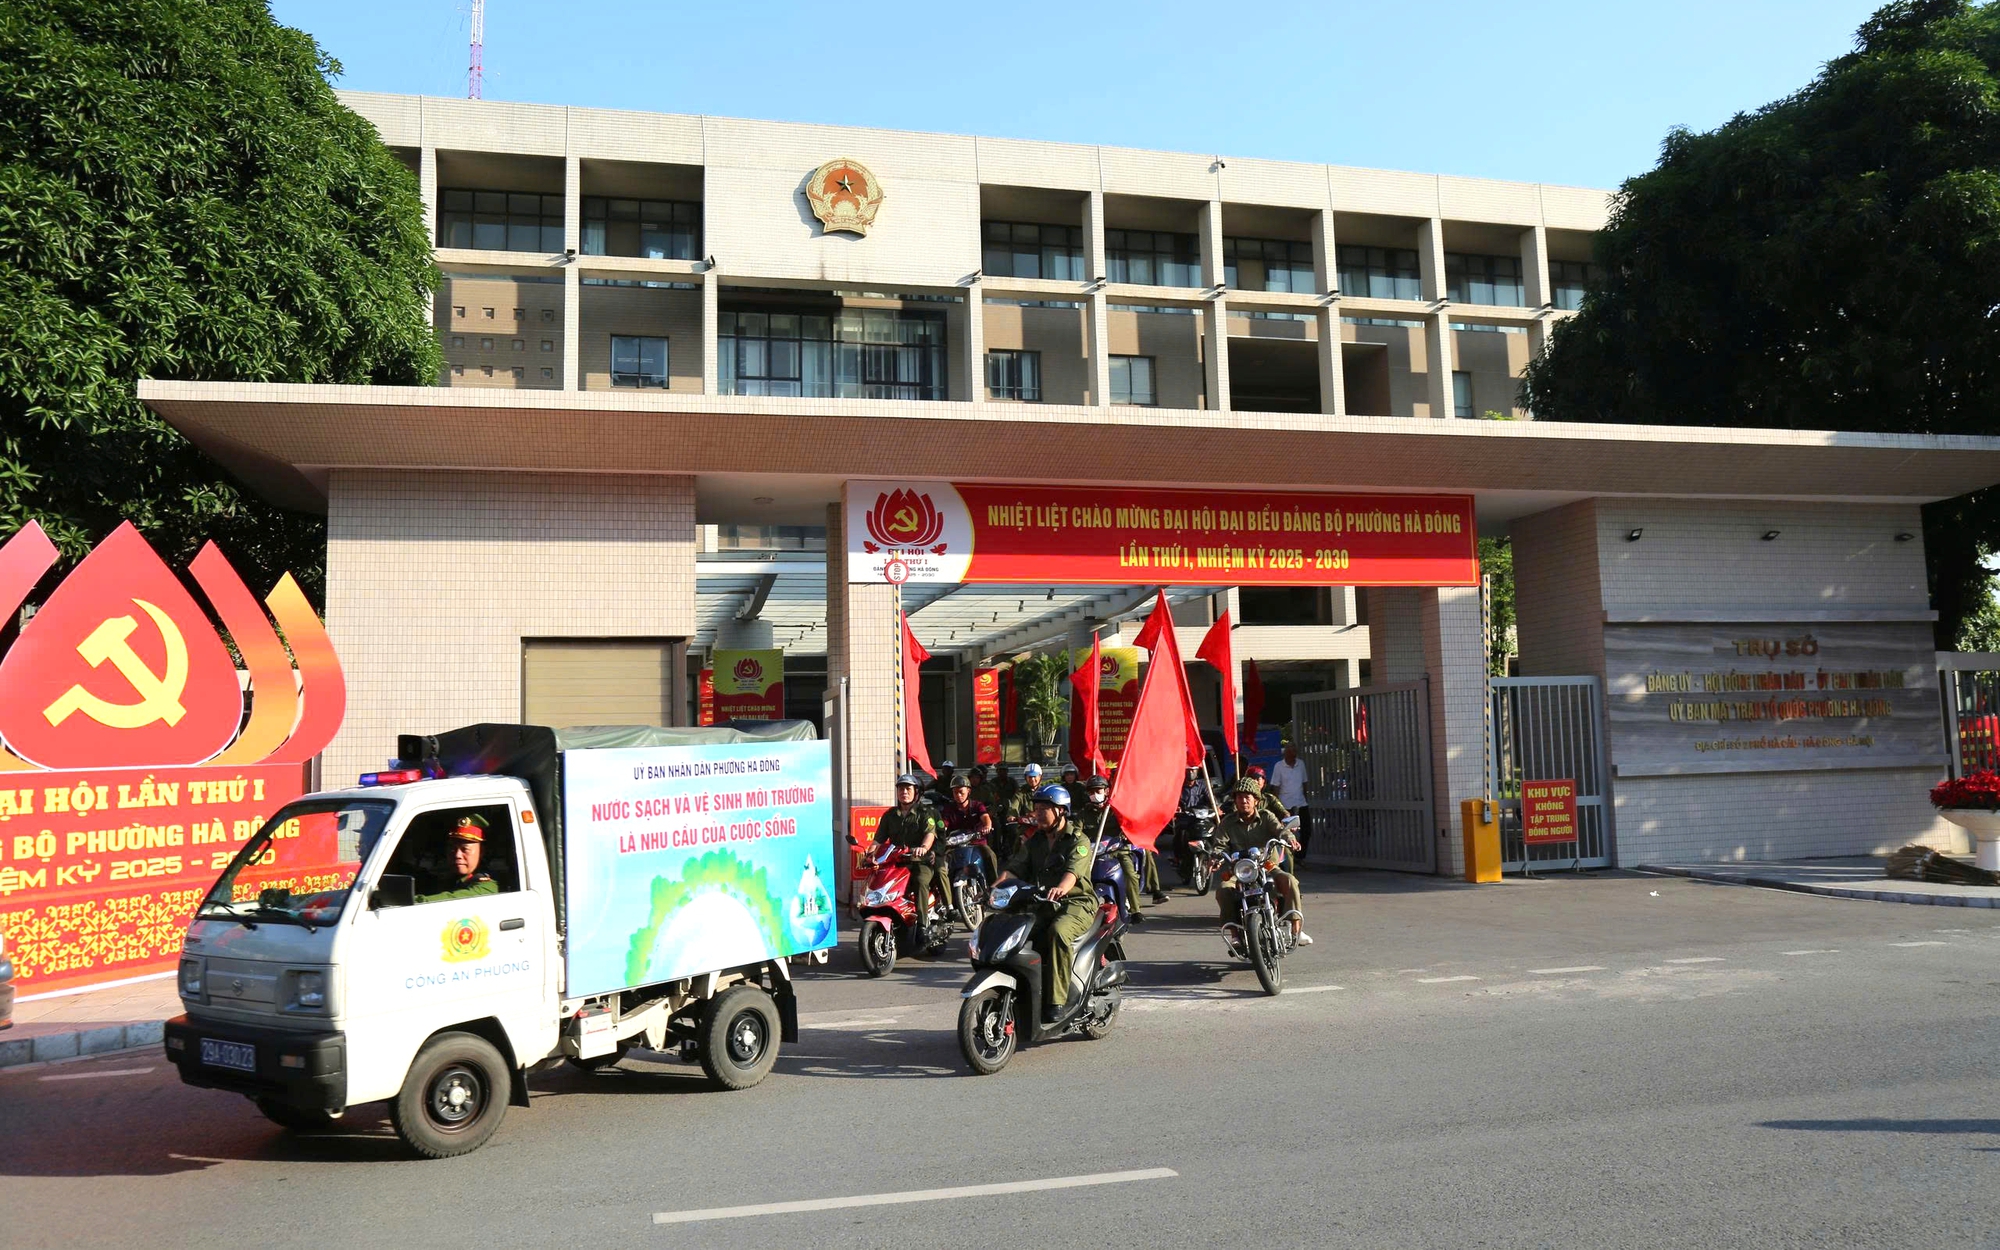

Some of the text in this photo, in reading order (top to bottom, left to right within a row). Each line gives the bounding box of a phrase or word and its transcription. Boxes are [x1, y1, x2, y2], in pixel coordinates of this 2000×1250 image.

[988, 502, 1461, 537] NHIỆT LIỆT CHÀO MỪNG ĐẠI HỘI ĐẠI BIỂU ĐẢNG BỘ PHƯỜNG HÀ ĐÔNG
[1120, 539, 1149, 568] LẦN
[1152, 542, 1181, 568] THỨ
[1184, 547, 1194, 570] I,
[1197, 543, 1245, 572] NHIỆM
[1248, 543, 1266, 569] KỲ
[1269, 548, 1304, 570] 2025
[1315, 548, 1349, 570] 2030
[893, 563, 901, 581] STOP
[1731, 633, 1819, 661] TRỤ SỞ
[1646, 668, 1676, 692] ĐẢNG
[1686, 702, 1709, 721] BAN
[648, 765, 666, 779] BAN
[668, 762, 692, 778] NHÂN
[694, 761, 711, 776] DÂN
[714, 759, 745, 775] PHƯỜNG
[760, 758, 780, 772] ĐÔNG
[44, 780, 109, 817] HỘI
[117, 774, 180, 809] LẦN
[187, 774, 248, 804] THỨ
[253, 779, 265, 801] I
[592, 785, 815, 822] NƯỚC SẠCH VÀ VỆ SINH MÔI TRƯỜNG
[1527, 786, 1571, 799] KHU VỰC
[1535, 800, 1564, 811] KHÔNG
[860, 815, 876, 827] VÀO
[1528, 824, 1573, 836] ĐÔNG NGƯỜI
[1530, 813, 1570, 825] TẬP TRUNG
[13, 829, 57, 863] BỘ
[66, 822, 184, 855] PHƯỜNG
[191, 817, 227, 845] HÀ
[620, 815, 796, 853] LÀ NHU CẦU CỦA CUỘC SỐNG
[56, 859, 101, 886] KỲ
[110, 856, 183, 880] 2025
[405, 973, 446, 989] CÔNG
[452, 970, 470, 982] AN
